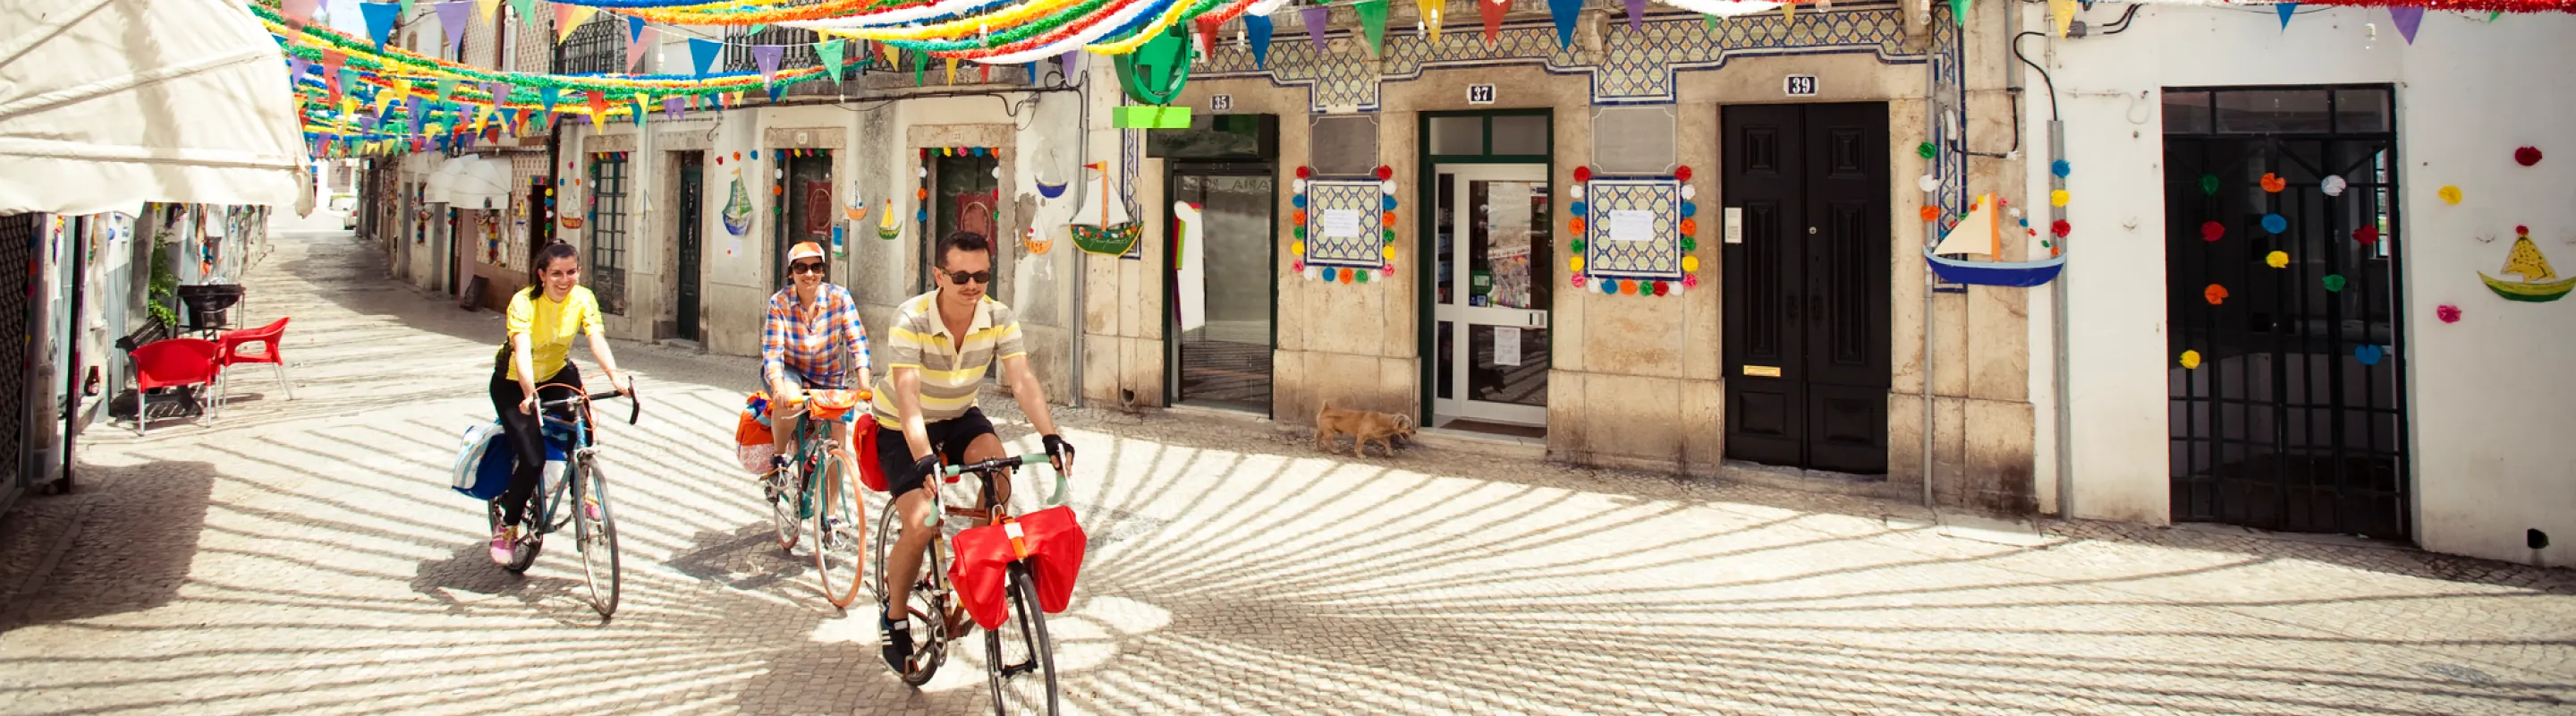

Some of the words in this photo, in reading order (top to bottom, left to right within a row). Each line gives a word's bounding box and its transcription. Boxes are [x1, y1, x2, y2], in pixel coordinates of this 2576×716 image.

[1792, 77, 1810, 94] 39
[1473, 86, 1489, 101] 37
[1215, 96, 1227, 109] 35
